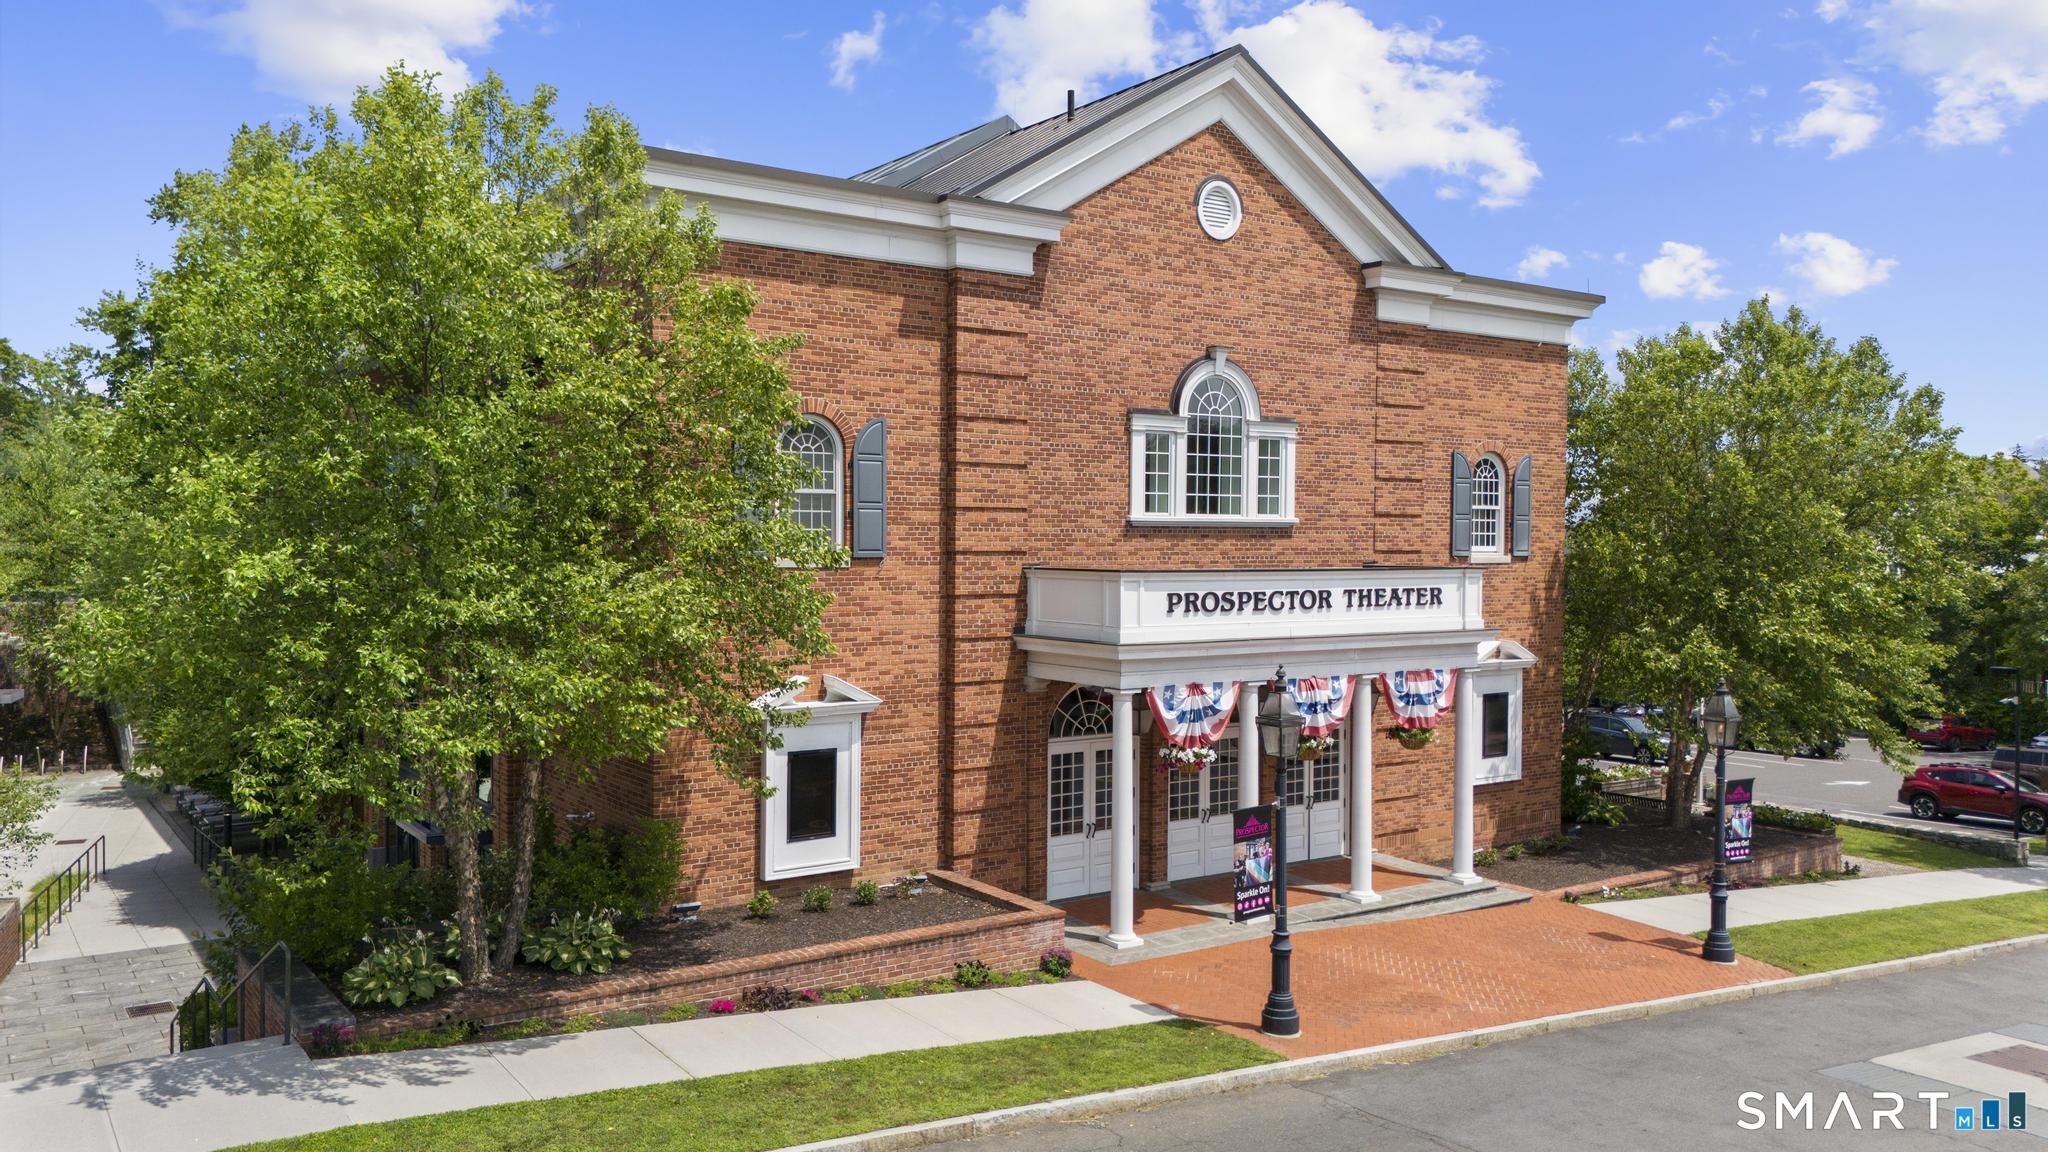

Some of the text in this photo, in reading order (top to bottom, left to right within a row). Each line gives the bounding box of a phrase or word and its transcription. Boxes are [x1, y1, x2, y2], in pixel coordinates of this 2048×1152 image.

[1166, 586, 1443, 614] PROSPECTOR THEATER
[1237, 884, 1270, 901] Sparkle On!
